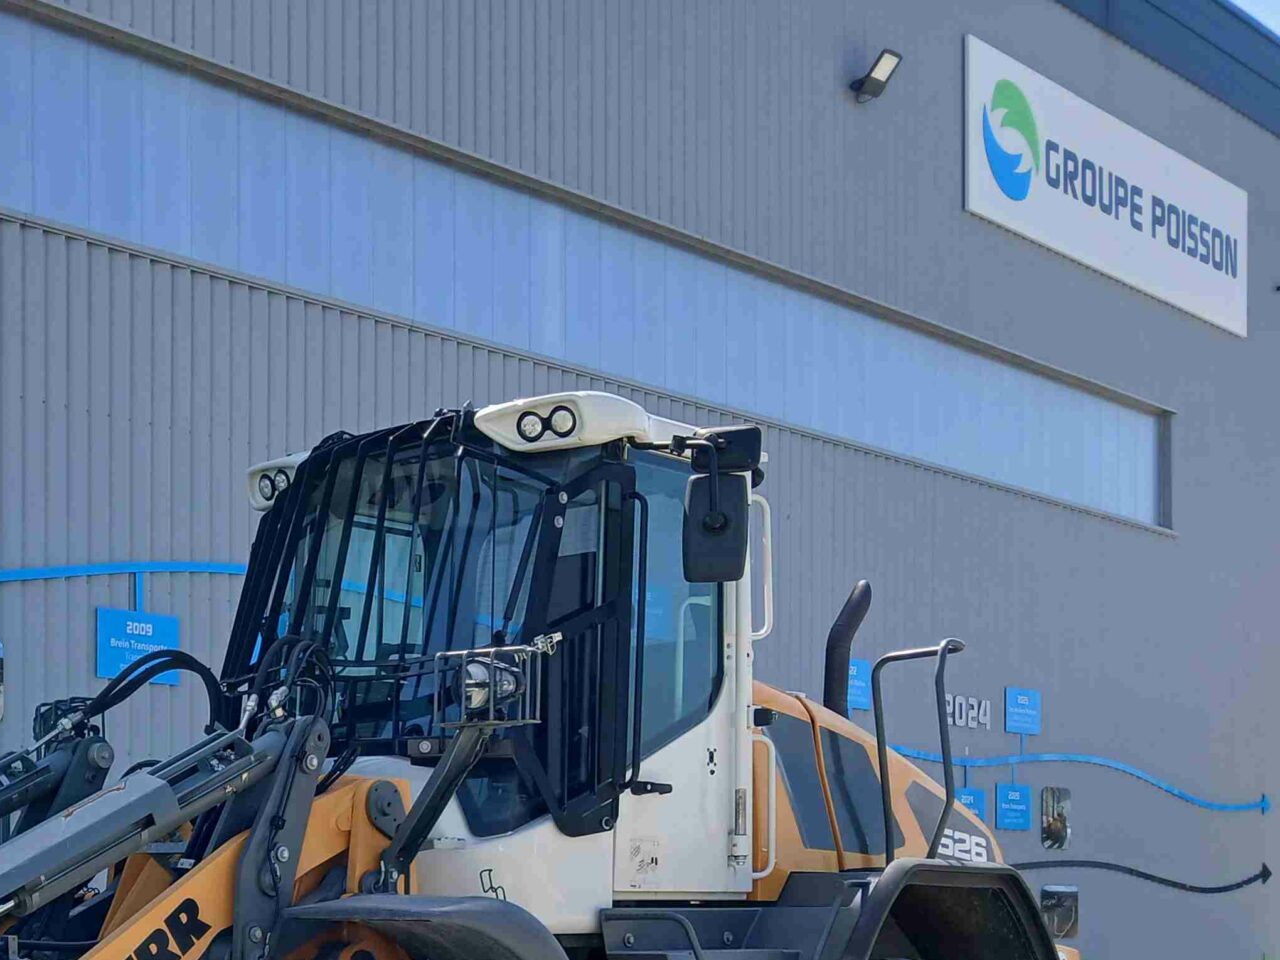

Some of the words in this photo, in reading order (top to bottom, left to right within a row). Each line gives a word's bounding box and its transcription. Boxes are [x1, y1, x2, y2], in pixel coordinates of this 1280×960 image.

[1045, 138, 1144, 233] GROUPE
[1150, 194, 1238, 279] POISSON
[126, 621, 153, 636] 2009
[945, 692, 991, 730] 2024
